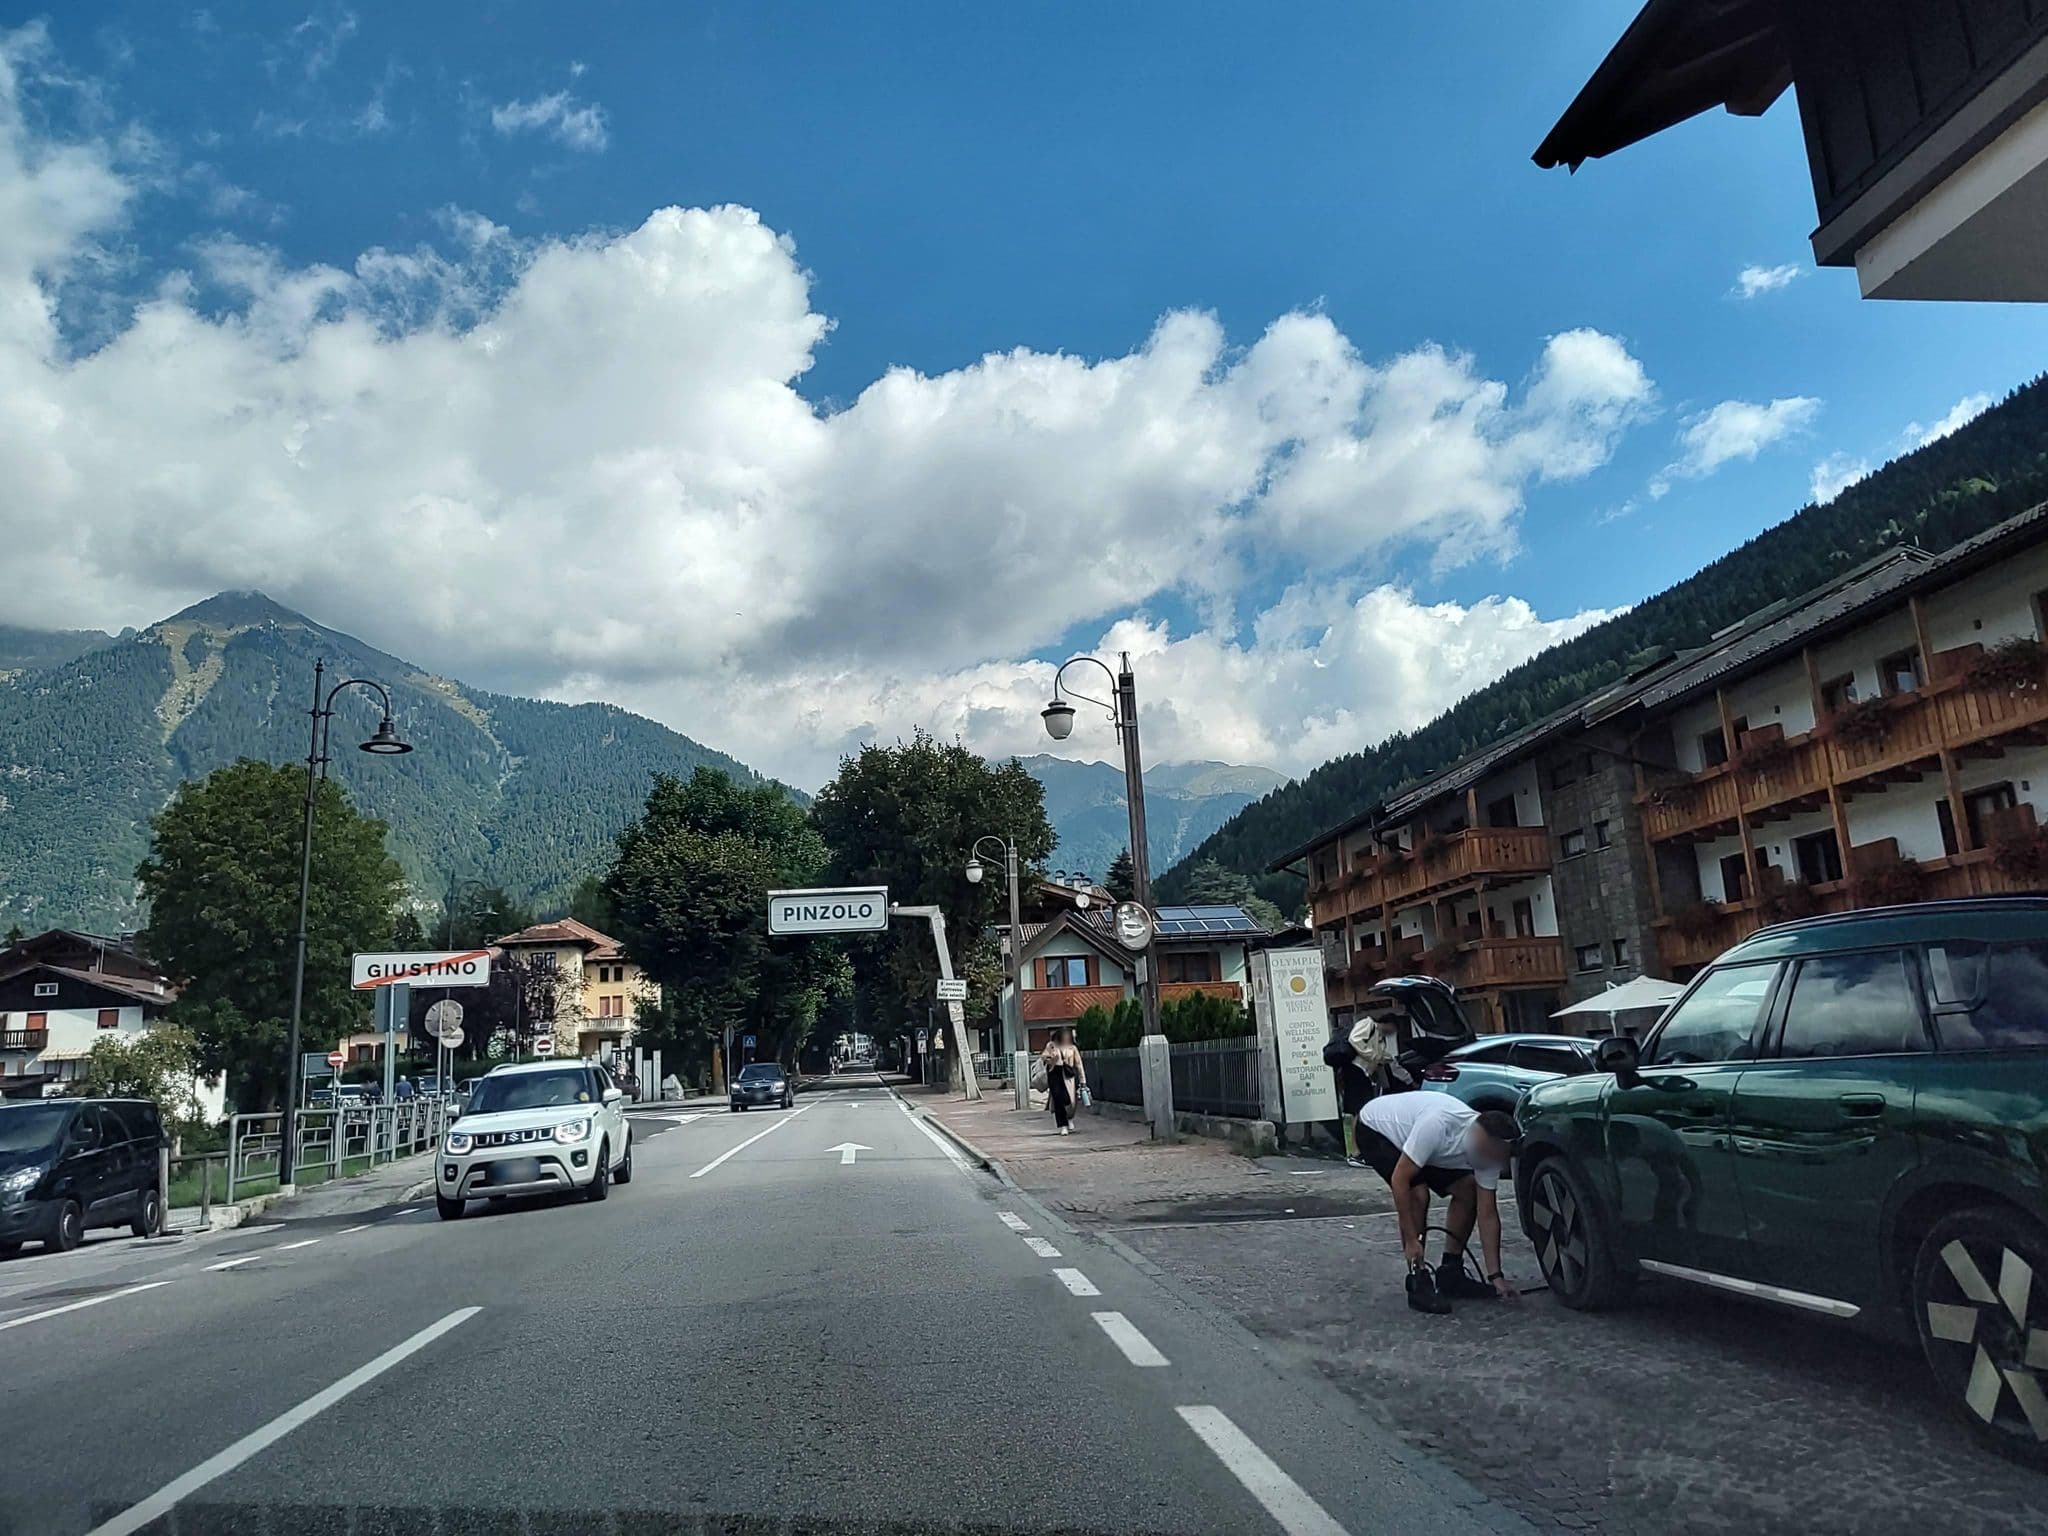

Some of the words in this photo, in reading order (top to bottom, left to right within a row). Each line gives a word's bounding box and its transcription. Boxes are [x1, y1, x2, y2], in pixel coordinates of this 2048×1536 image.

[783, 903, 873, 922] PINZOLO
[1271, 957, 1320, 967] OLYMPIC
[367, 961, 477, 978] GIUSTINO
[1288, 1021, 1315, 1029] CENTRO
[1285, 1027, 1320, 1036] WELLNESS
[1291, 1035, 1315, 1043] SAUNA
[1291, 1050, 1318, 1058] PISCINA
[1286, 1065, 1328, 1074] RISTORANTE
[1299, 1073, 1315, 1081] BAR
[1291, 1087, 1327, 1097] SOLARIUM
